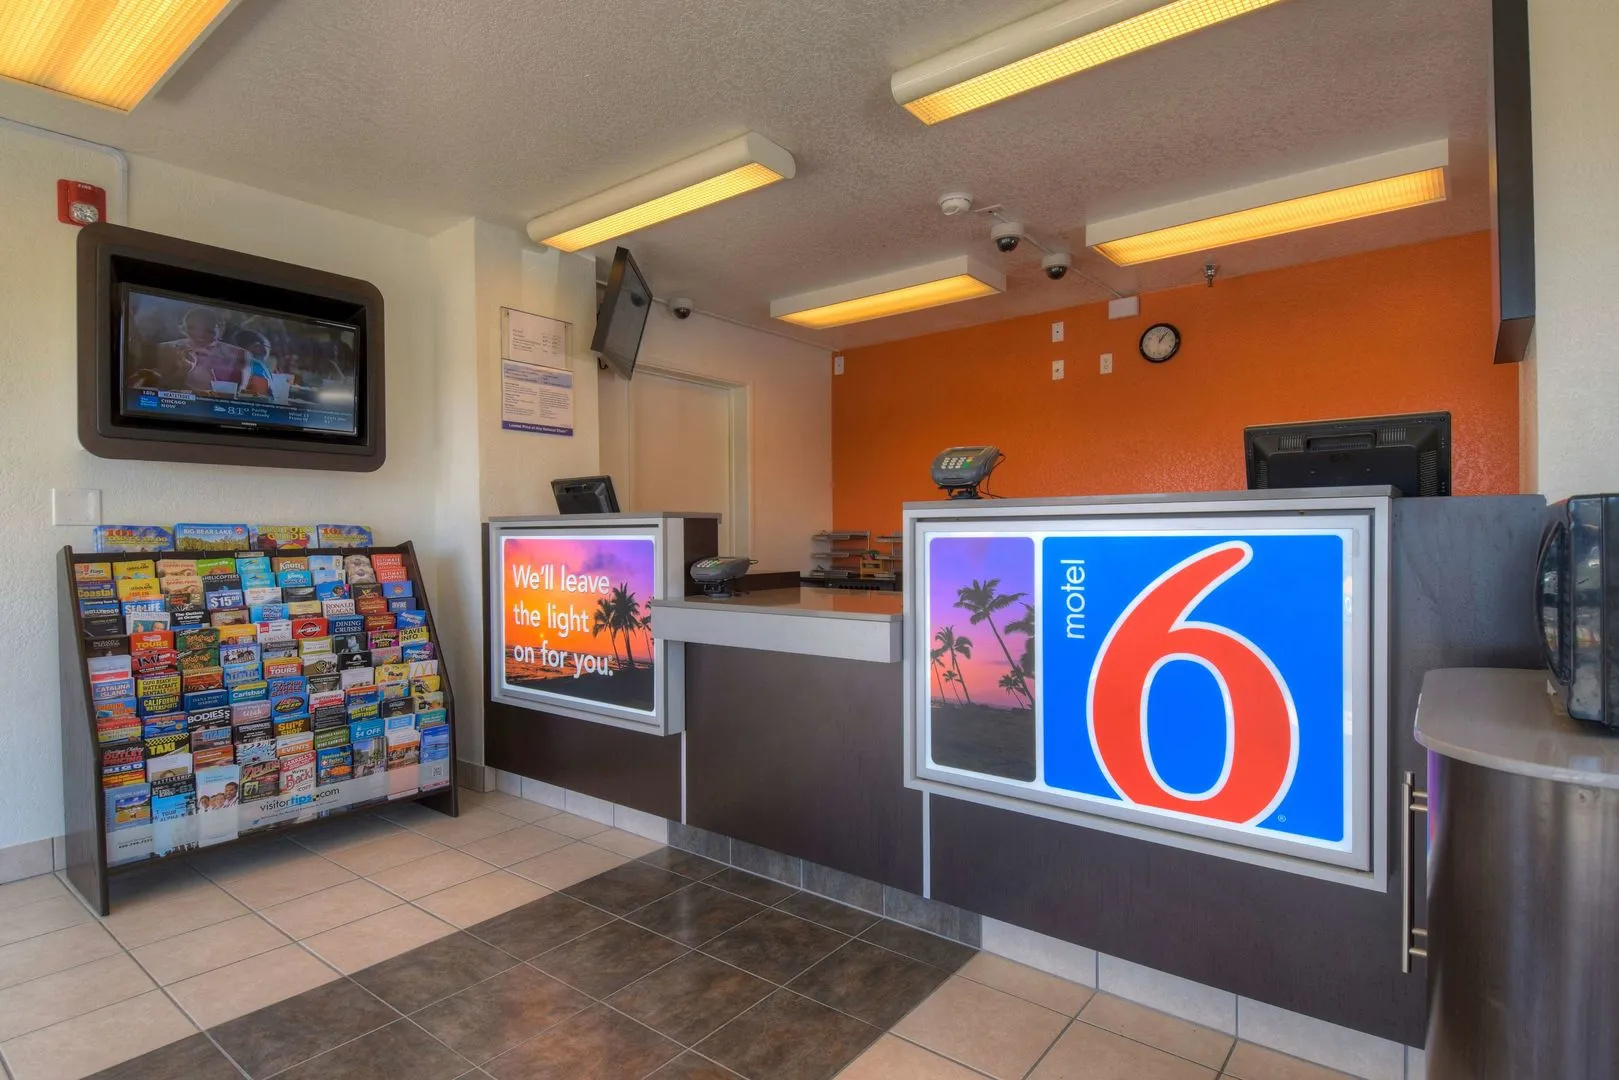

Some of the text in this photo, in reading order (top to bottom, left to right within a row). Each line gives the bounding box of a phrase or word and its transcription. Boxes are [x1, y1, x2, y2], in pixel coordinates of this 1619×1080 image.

[512, 564, 610, 595] We'll leave
[77, 588, 113, 597] Coastal
[1060, 559, 1085, 640] motel
[325, 602, 354, 610] RONALD
[512, 600, 590, 638] the light
[400, 626, 424, 635] TRAVEL
[400, 633, 419, 641] INFO
[135, 640, 169, 648] TOURS
[513, 644, 535, 664] on
[540, 639, 568, 669] for
[270, 666, 297, 675] TOURS
[96, 683, 131, 693] CATALINA
[143, 683, 177, 691] WATERCRAFT
[1087, 540, 1300, 827] 6
[100, 689, 127, 698] ISLAND
[143, 689, 167, 697] RENTALS
[232, 688, 266, 699] Carlsbad
[144, 695, 180, 706] CALIFORNIA
[145, 702, 179, 711] WATERSPORTS
[187, 710, 225, 724] BODIES
[278, 719, 305, 732] SURF
[280, 727, 302, 736] SHOP
[366, 727, 382, 736] OFF
[148, 742, 176, 756] TAXI
[281, 743, 310, 753] EVENTS
[286, 767, 314, 791] Back!
